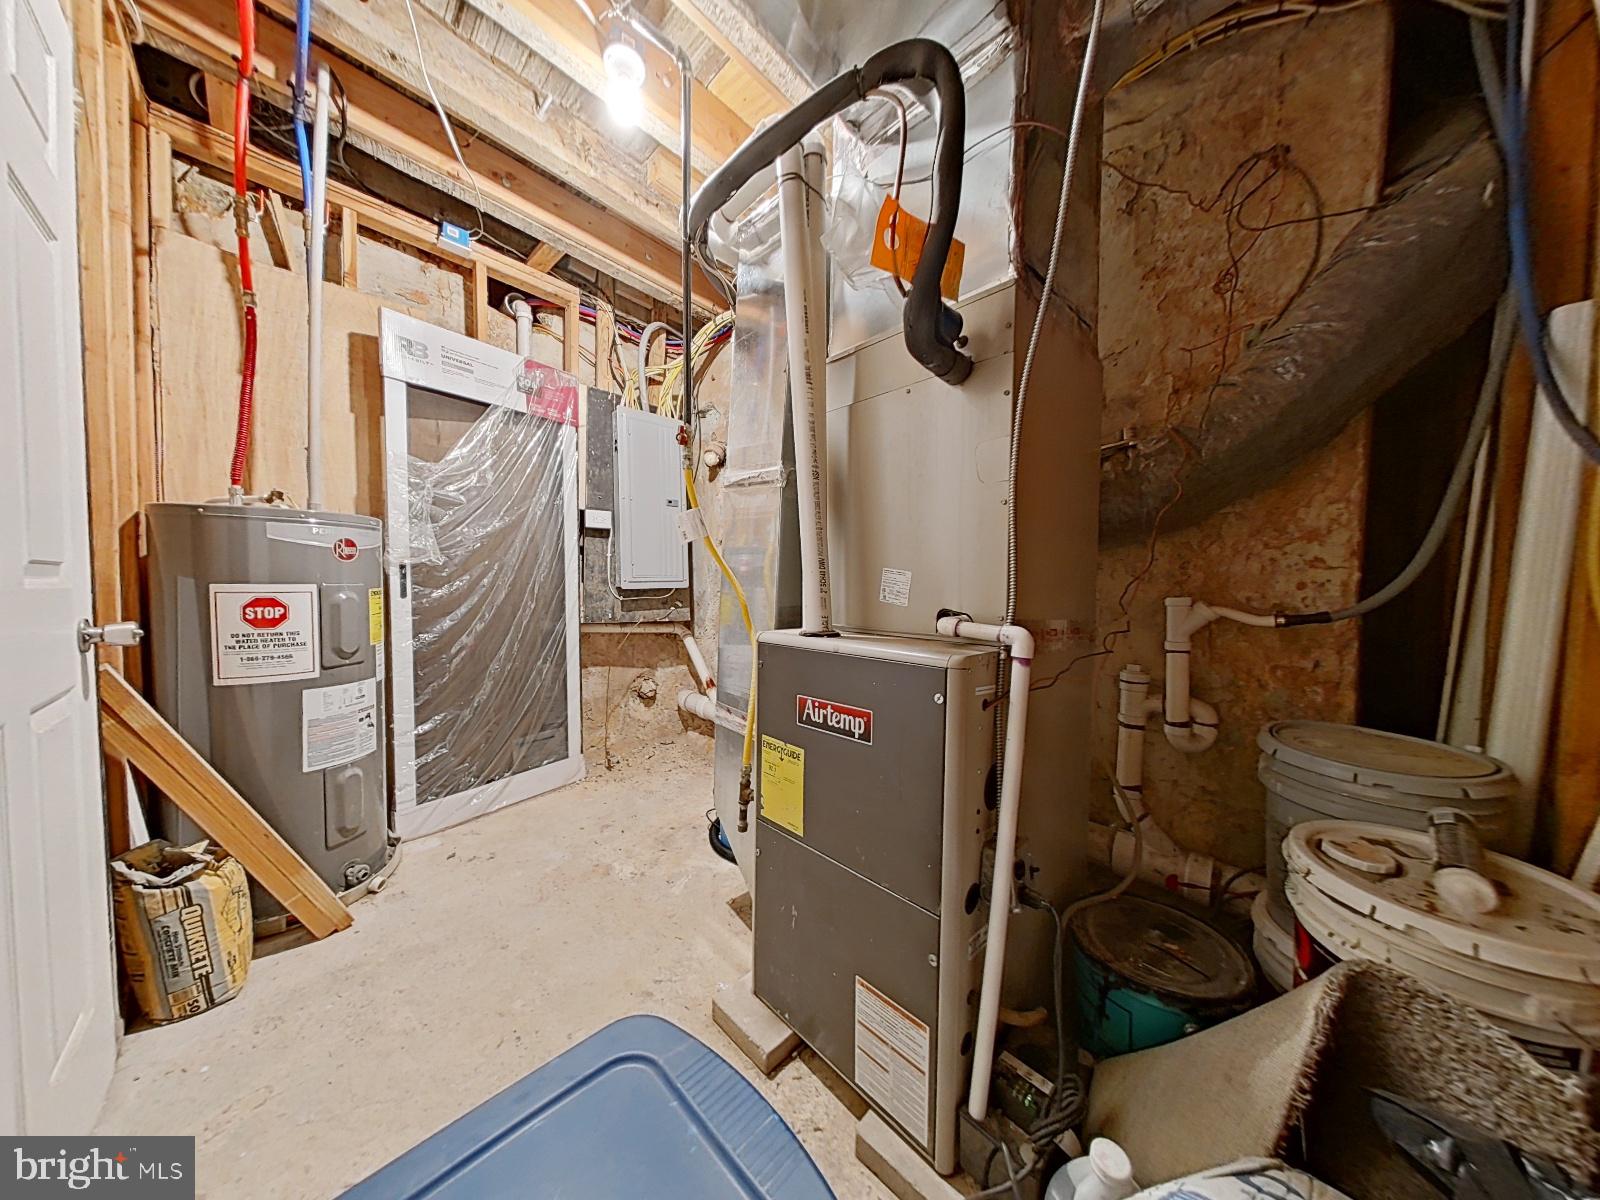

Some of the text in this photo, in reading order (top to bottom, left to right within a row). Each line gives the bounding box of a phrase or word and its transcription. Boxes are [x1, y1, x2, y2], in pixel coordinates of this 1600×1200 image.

[441, 353, 474, 368] UNIVERSAL
[244, 606, 285, 619] STOP
[803, 698, 865, 739] Airtemp
[181, 907, 210, 980] QUIKRETE
[187, 1000, 200, 1013] 50
